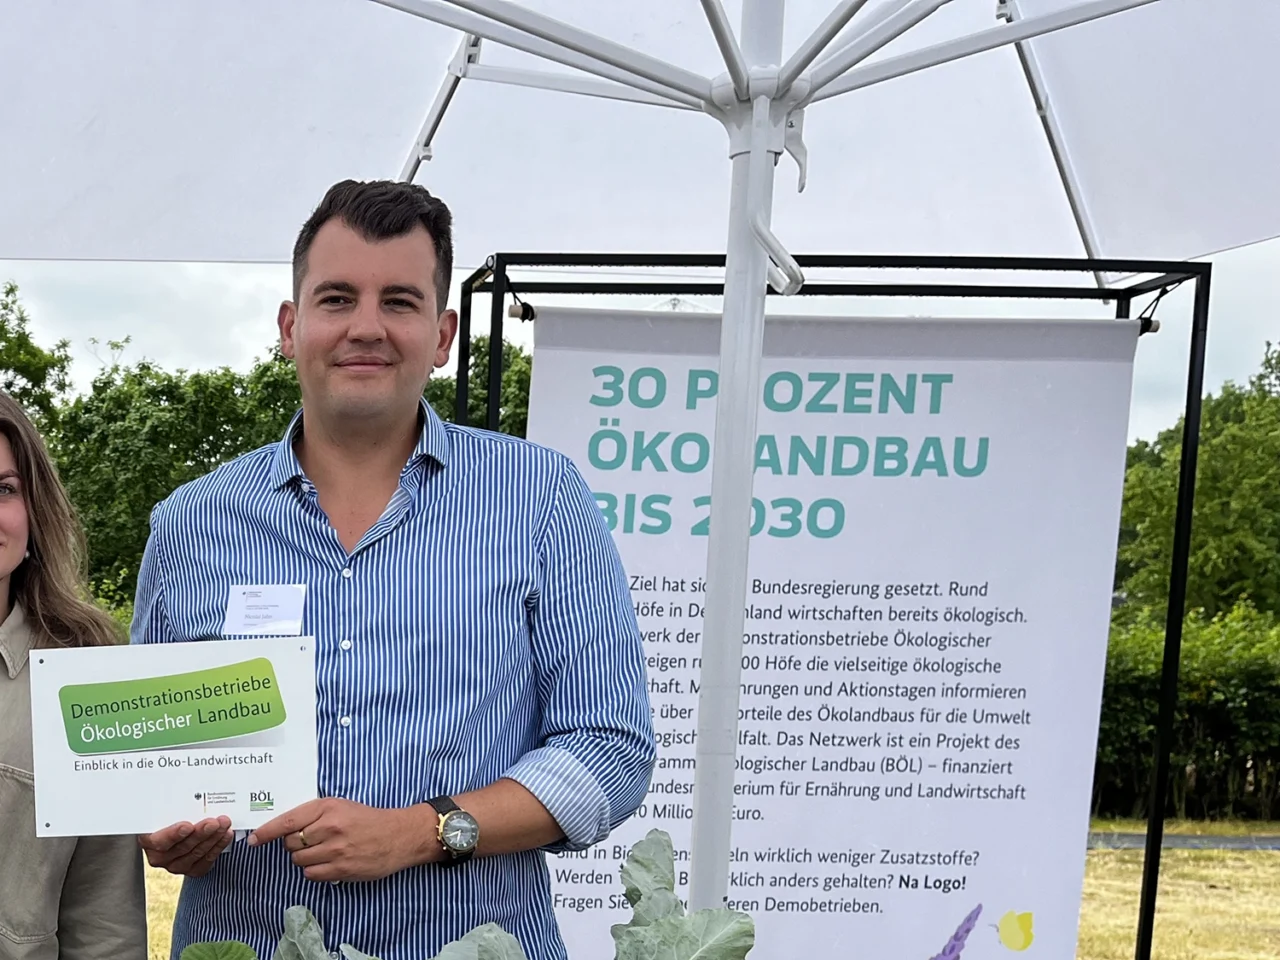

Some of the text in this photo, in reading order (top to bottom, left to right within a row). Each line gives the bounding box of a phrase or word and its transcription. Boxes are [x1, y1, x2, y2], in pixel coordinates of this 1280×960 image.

[589, 365, 954, 415] 30 POZENT
[587, 418, 990, 478] ÖKOANDBAU
[629, 575, 687, 594] Ziel hat
[751, 578, 989, 600] Bundesregierung gesetzt. Rund
[669, 602, 683, 618] in
[787, 604, 1027, 627] wirtschaften bereits ökologisch.
[675, 627, 701, 644] der
[893, 628, 992, 652] Ökologischer
[765, 654, 1002, 677] Höfe die vielseitige ökologische
[70, 675, 271, 719] Demonstrationsbetriebe
[803, 680, 1027, 702] und Aktionstagen informieren
[80, 701, 271, 743] Ökologischer Landbau
[659, 703, 695, 720] über
[786, 703, 1031, 725] des Ökolandbaus für die Umwelt
[776, 730, 804, 747] Das
[809, 731, 882, 748] Netzwerk
[886, 732, 905, 748] ist
[908, 732, 931, 748] ein
[936, 732, 990, 753] Projekt
[994, 733, 1020, 750] des
[74, 752, 274, 771] Einblick in die Öko-Landwirtschaft
[811, 754, 1013, 776] Landbau (BÖL) finanziert
[250, 790, 274, 802] BÖL
[779, 780, 1026, 802] für Ernährung und Landwirtschaft
[753, 847, 813, 864] wirklich
[817, 848, 876, 868] weniger
[879, 849, 980, 866] Zusatzstoffe?
[555, 868, 613, 885] Werden
[769, 872, 967, 894] anders gehalten? Na Logo!
[554, 893, 629, 913] Fragen Sie
[764, 896, 883, 914] Demobetrieben.
